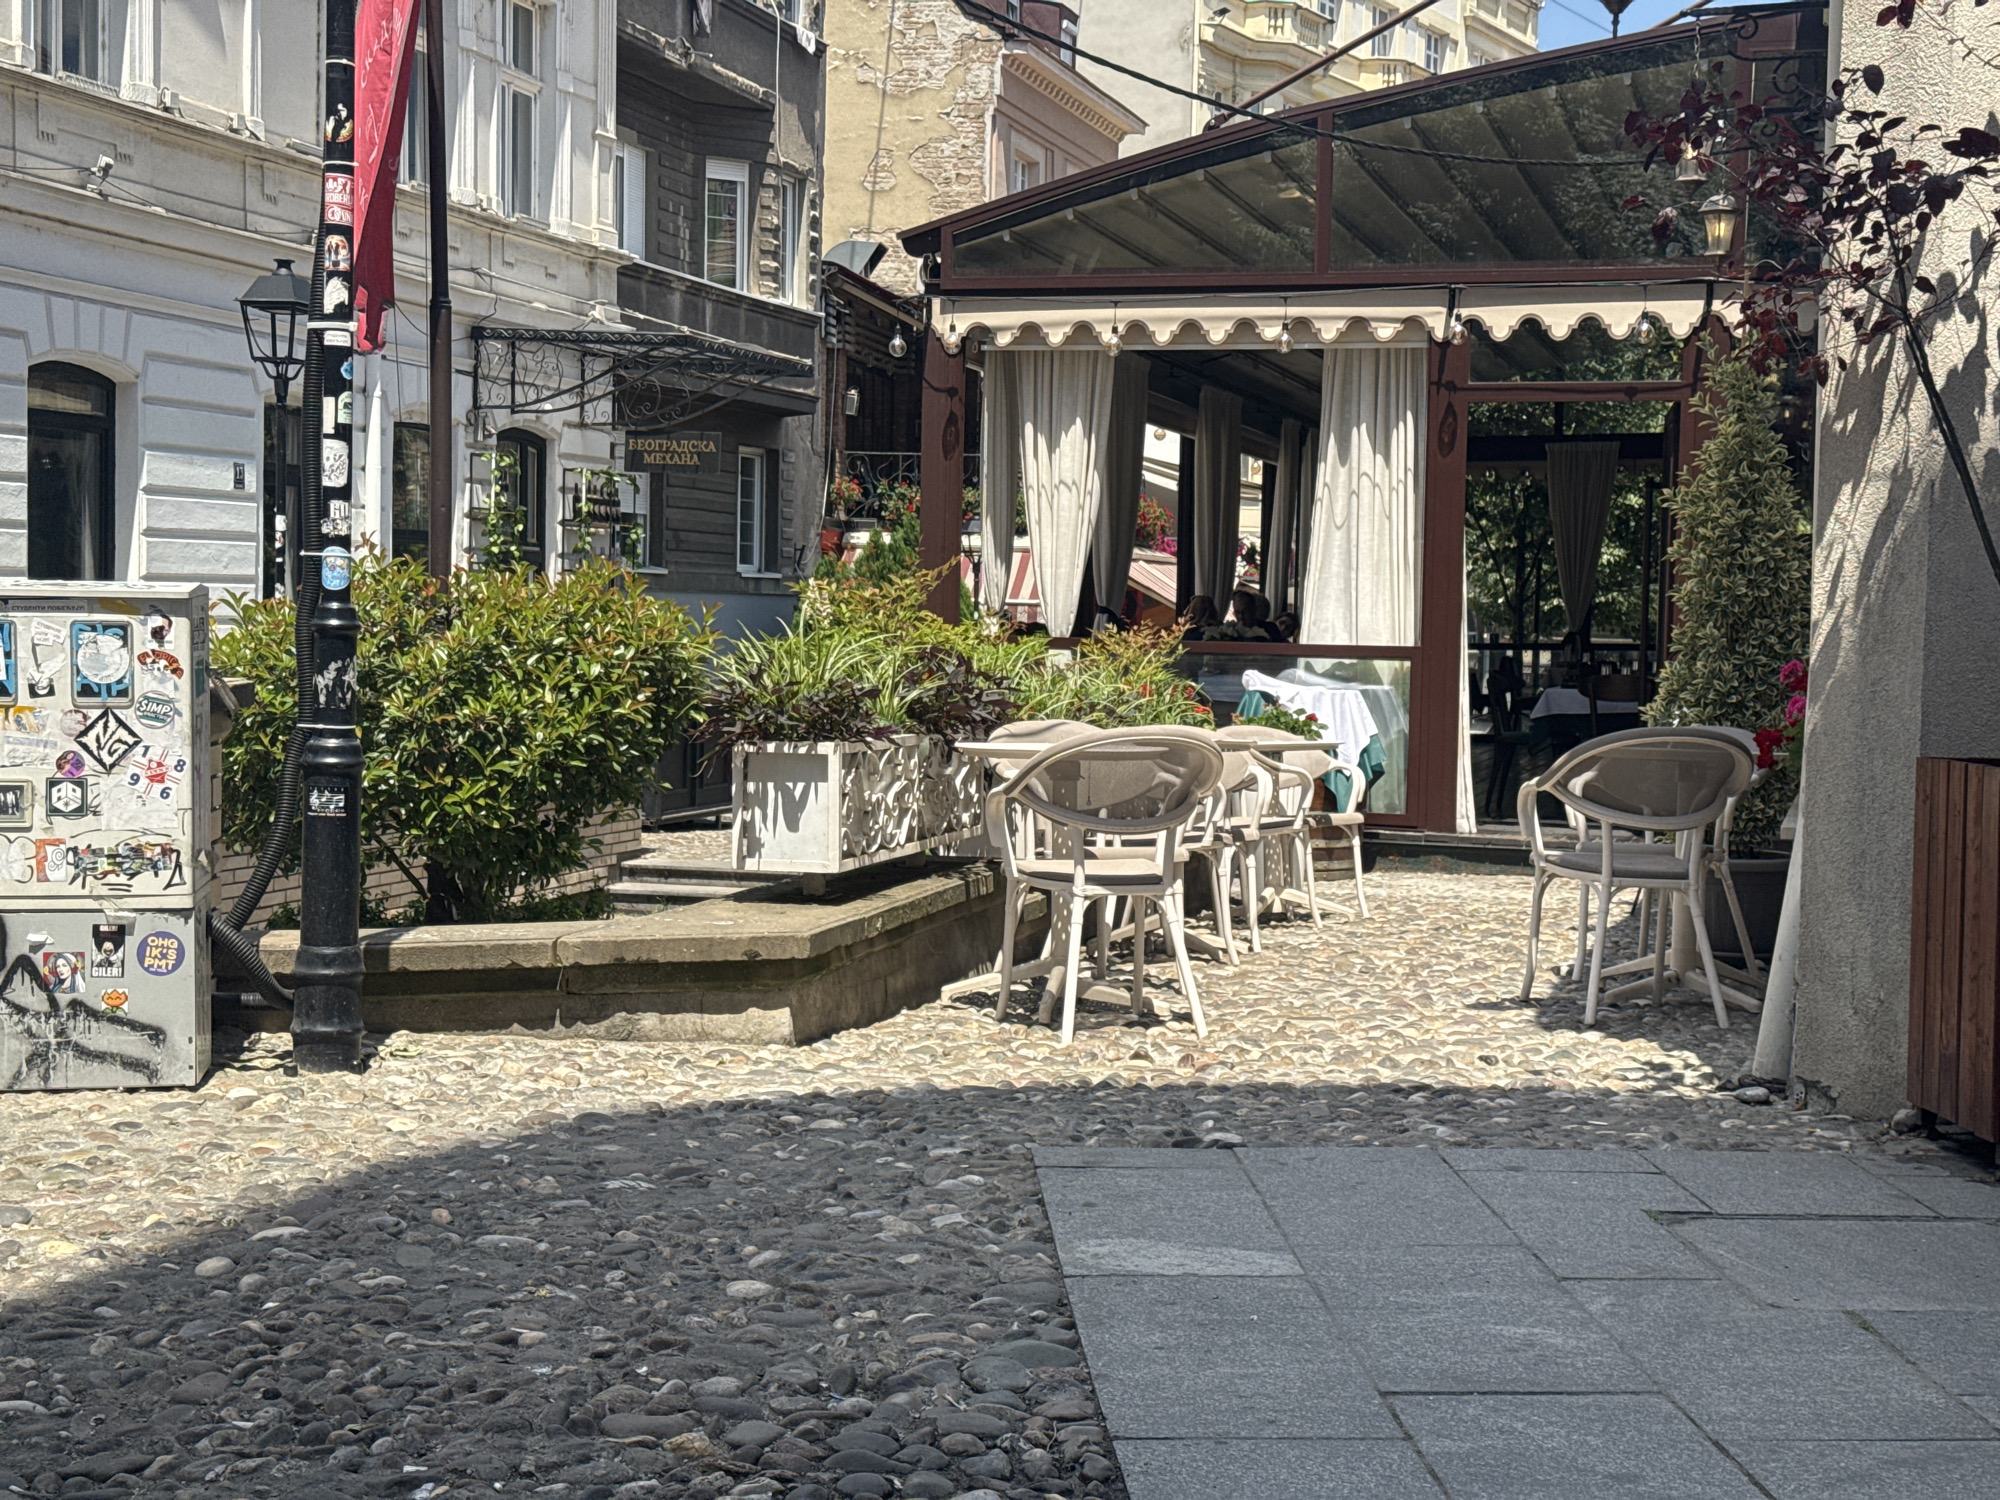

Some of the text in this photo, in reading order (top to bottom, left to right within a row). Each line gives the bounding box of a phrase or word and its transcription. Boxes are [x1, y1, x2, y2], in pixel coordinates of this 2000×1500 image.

[628, 439, 717, 453] БЕОГРАДСКА
[643, 452, 700, 465] МЕХАНА
[145, 946, 177, 959] IK'S
[144, 957, 176, 970] PMT
[92, 967, 122, 977] GILER!
